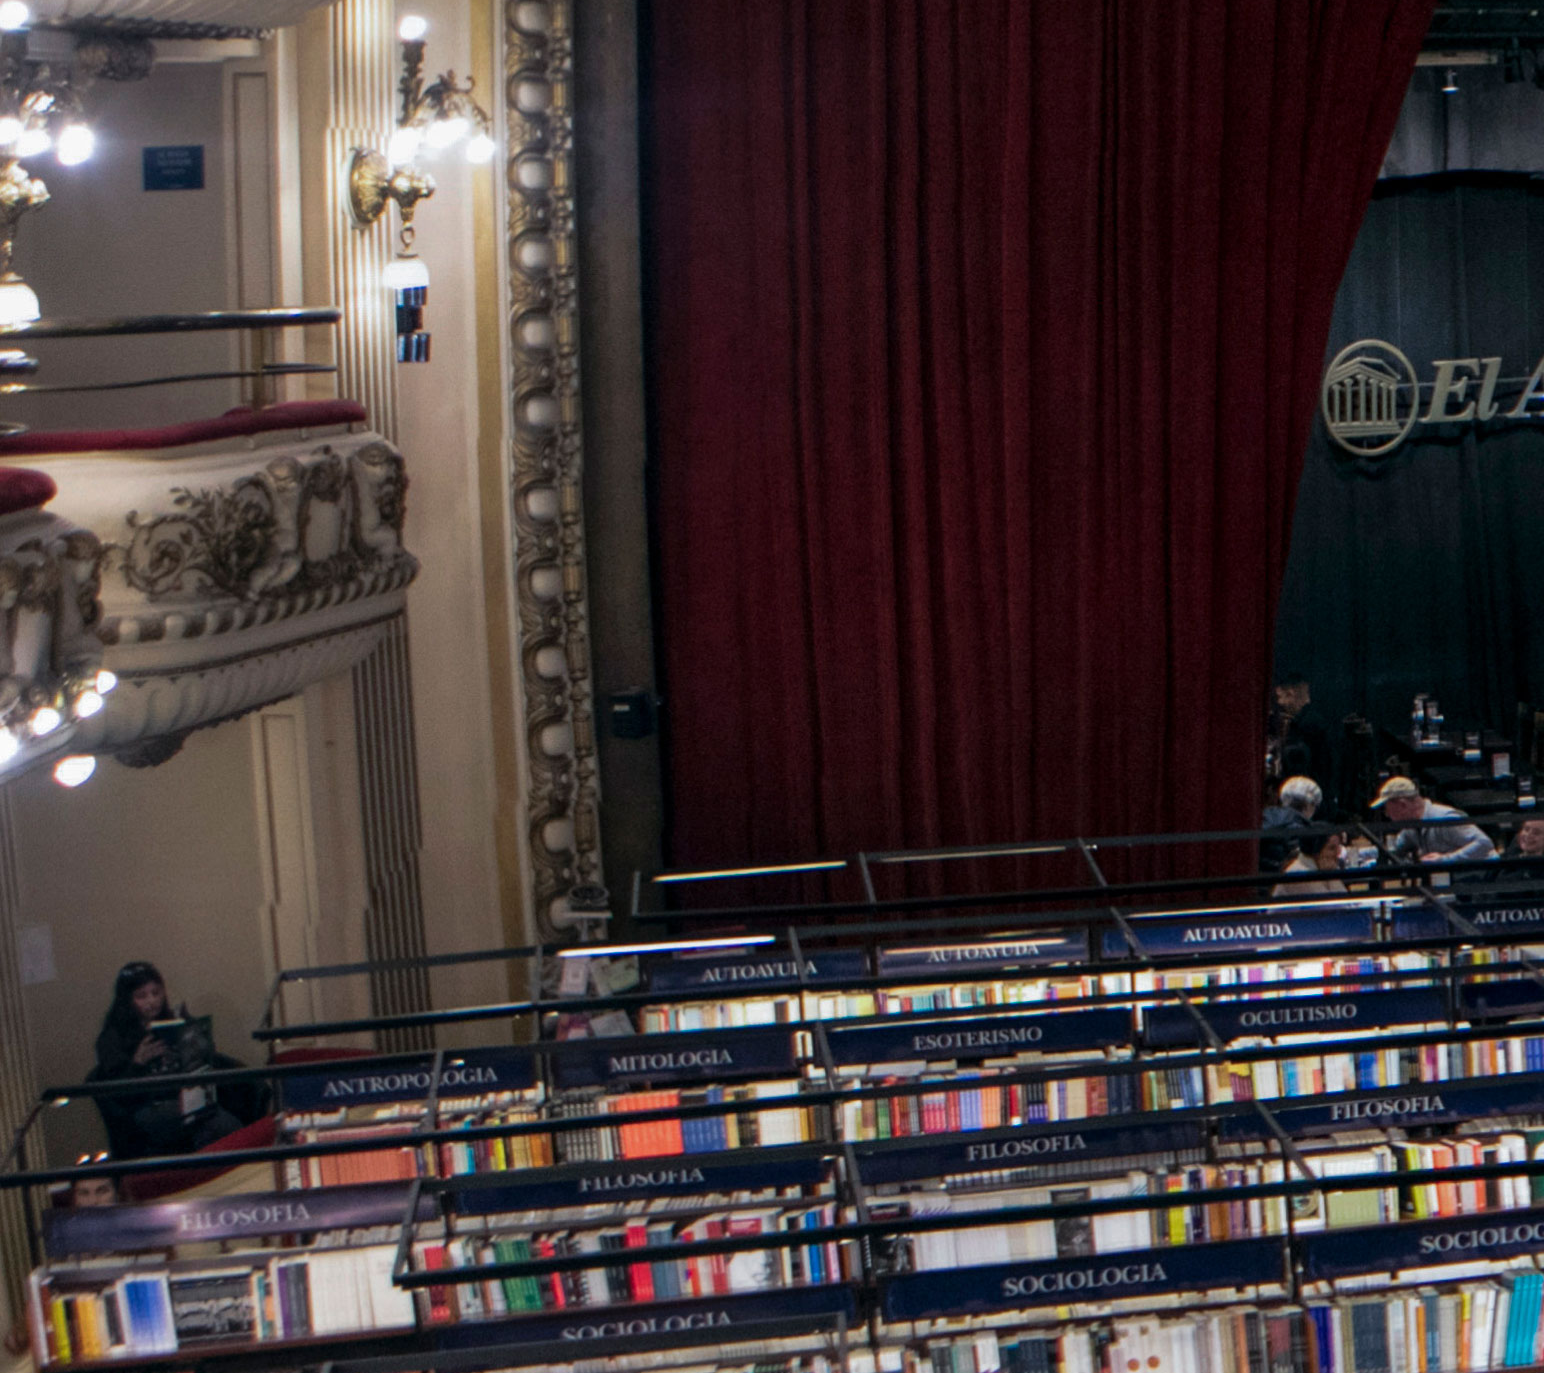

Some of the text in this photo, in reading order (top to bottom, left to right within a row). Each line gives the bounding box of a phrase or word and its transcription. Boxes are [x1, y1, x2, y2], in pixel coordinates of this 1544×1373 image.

[1420, 357, 1502, 424] El
[1183, 922, 1293, 943] AUTOAYUDA
[925, 940, 1040, 964] AUTOAYUDA
[1240, 1002, 1357, 1027] OCULTISMO
[913, 1025, 1043, 1051] ESOTERISMO
[609, 1048, 734, 1074] MITOLOGIA
[1331, 1095, 1445, 1122] FILOSOFIA
[966, 1132, 1087, 1162] FILOSOFIA
[179, 1202, 311, 1232] FILOSOFIA
[1003, 1263, 1168, 1298] SOCIOLOGIA
[560, 1310, 734, 1339] SOCIOLOGIA
